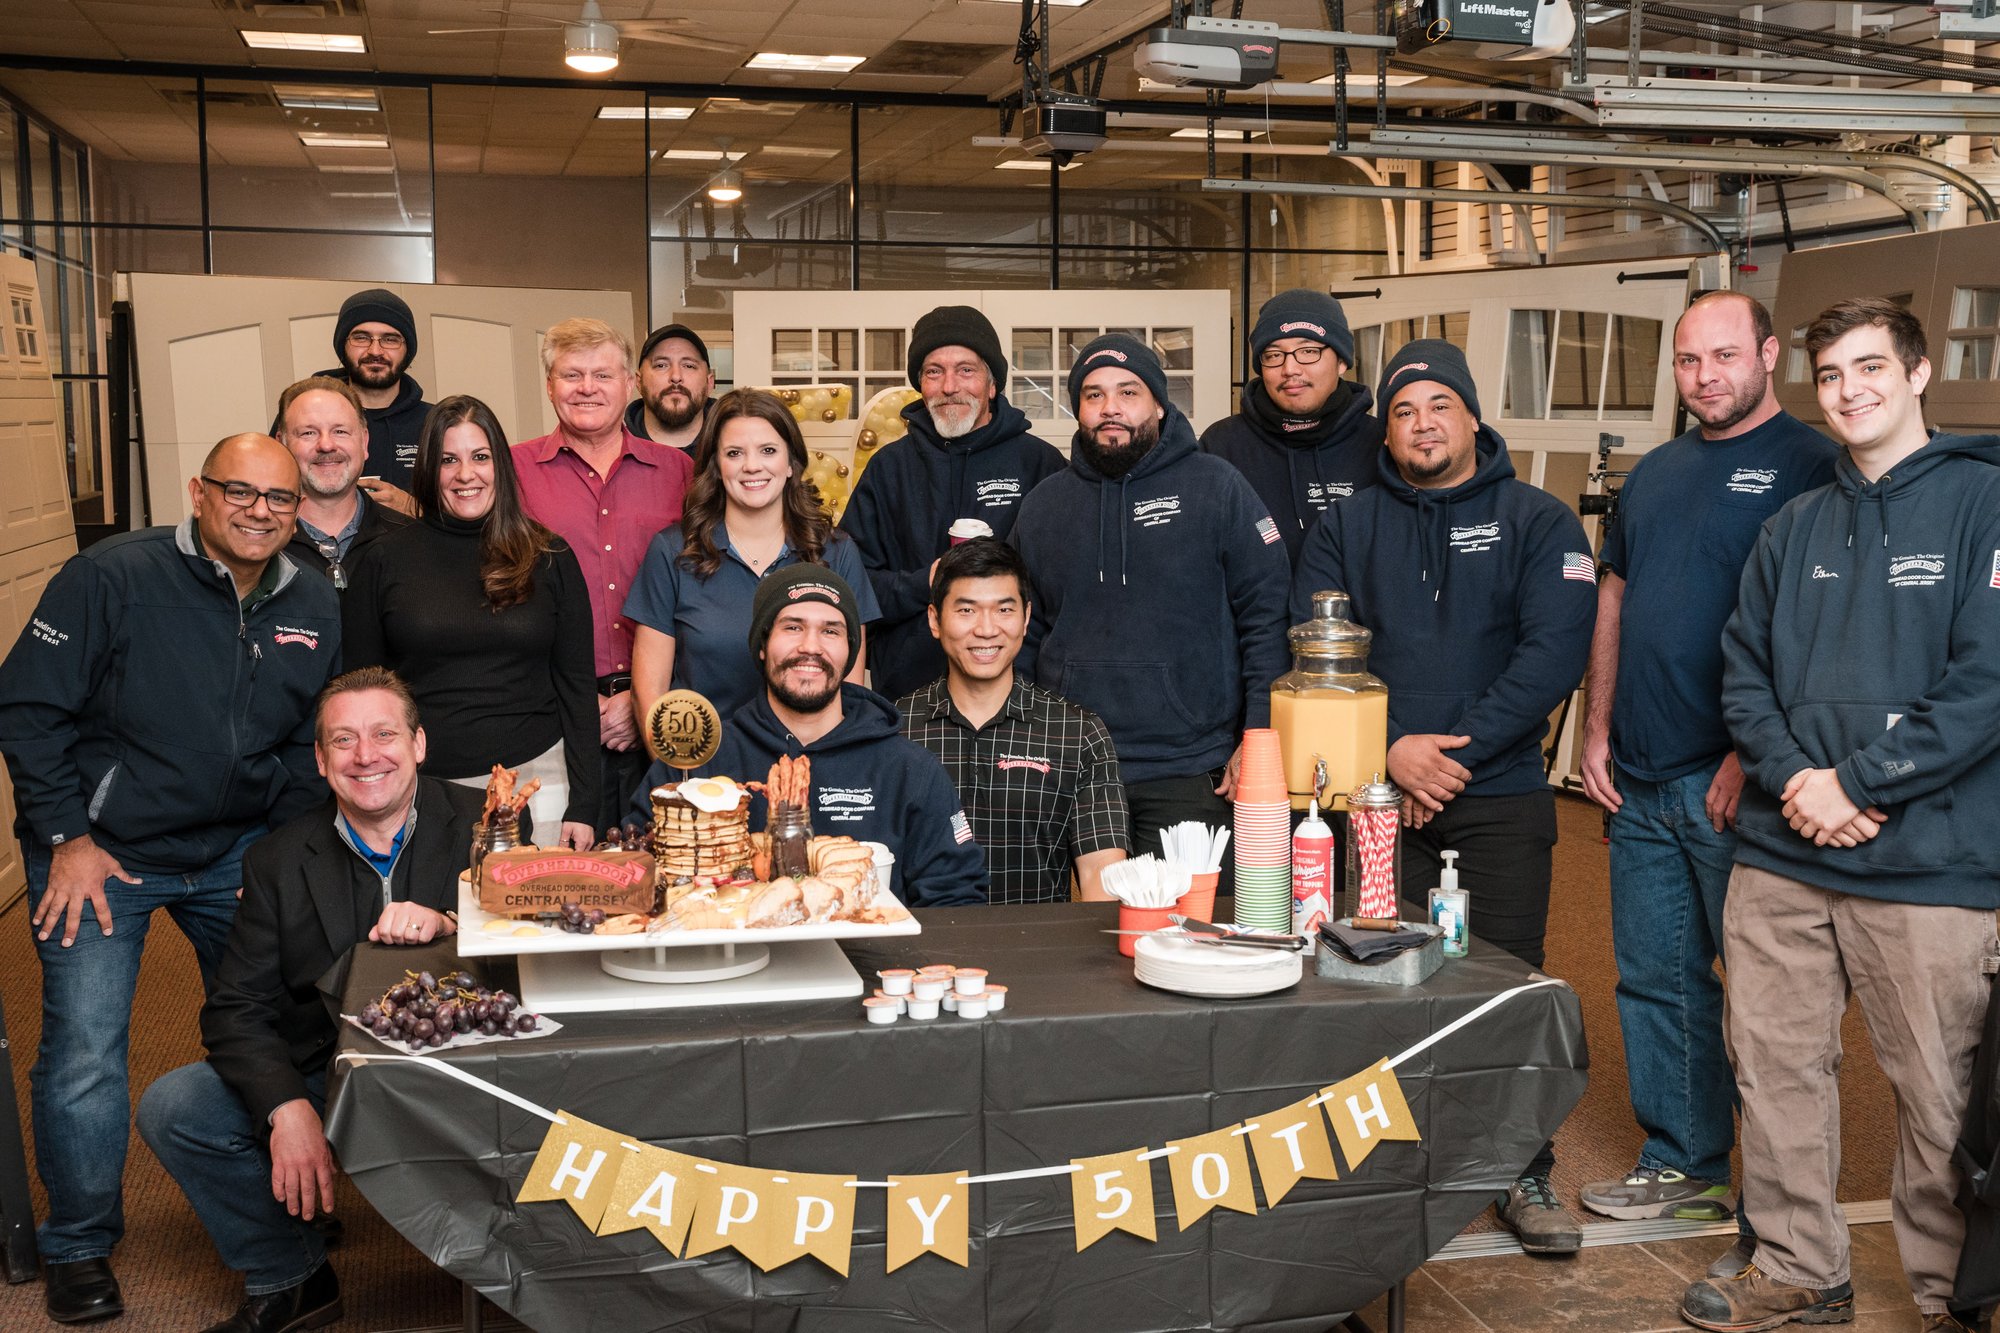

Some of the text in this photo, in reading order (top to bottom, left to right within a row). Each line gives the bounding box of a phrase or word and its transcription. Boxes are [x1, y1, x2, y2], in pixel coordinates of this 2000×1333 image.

[32, 628, 60, 646] the Best
[33, 617, 69, 641] Building on
[668, 710, 698, 735] 50
[507, 859, 629, 883] OVERHEAD DOOR
[505, 894, 629, 906] CENTRAL JERSEY
[520, 884, 563, 893] OVERHEAD
[564, 884, 587, 893] DOOR
[603, 884, 615, 892] OF
[549, 1082, 1391, 1246] HAPPY 50TH
